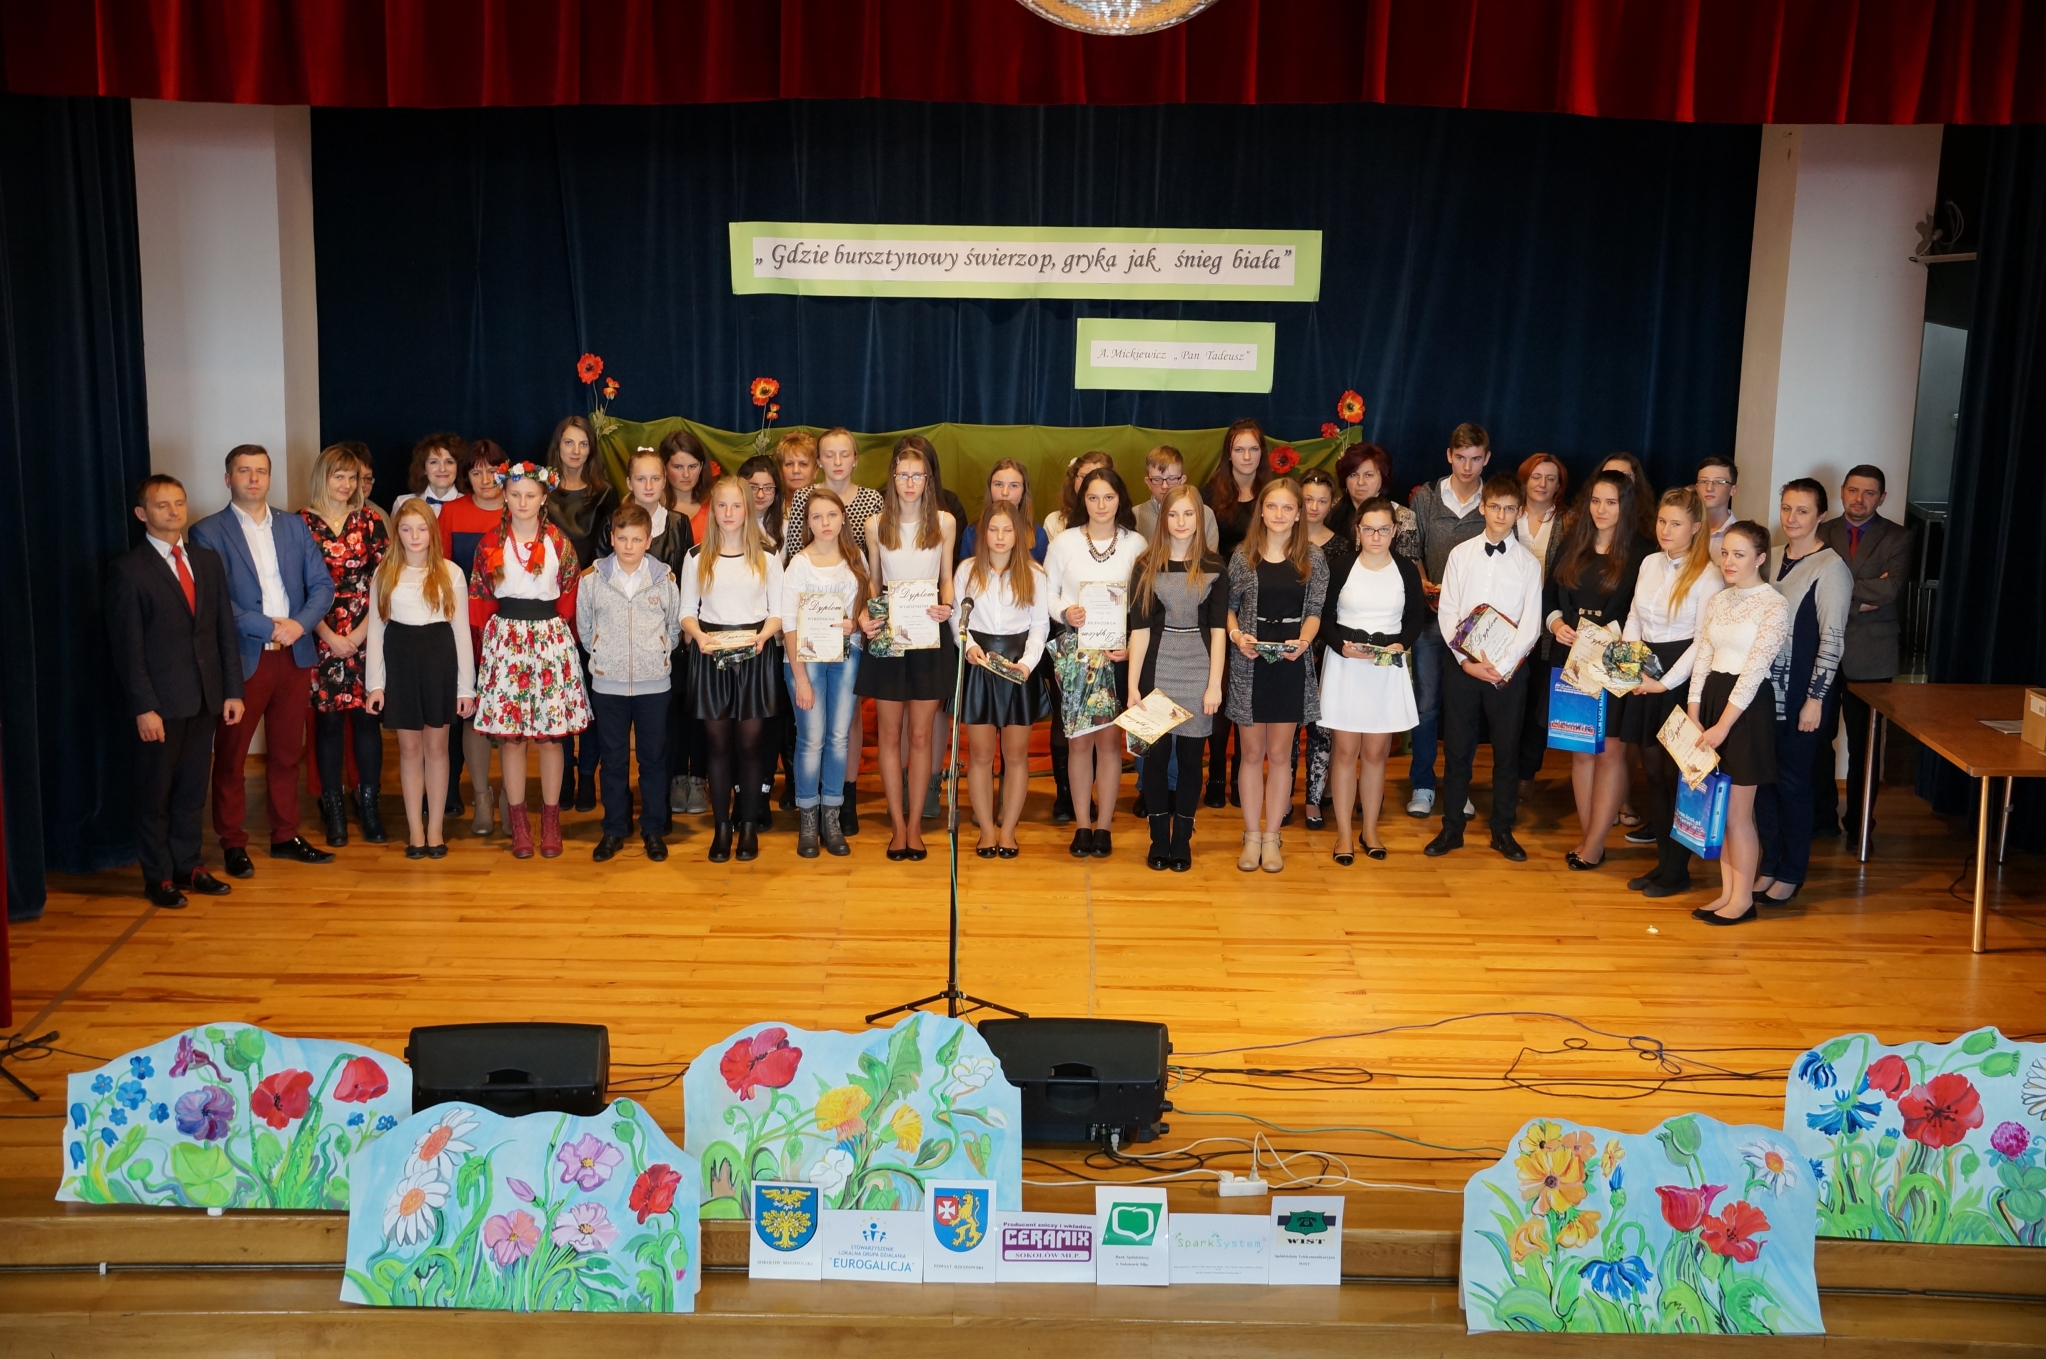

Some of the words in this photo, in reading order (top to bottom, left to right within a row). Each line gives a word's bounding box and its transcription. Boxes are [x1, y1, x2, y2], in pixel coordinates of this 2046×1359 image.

[834, 244, 959, 272] bursztynowy
[964, 247, 1056, 273] świerzop,
[1061, 247, 1117, 274] gryka
[1123, 247, 1161, 274] jak
[1174, 249, 1223, 275] śnieg
[1097, 349, 1109, 359] A.
[1111, 348, 1167, 361] Mickiewicz
[899, 587, 935, 602] Dyplom
[808, 599, 842, 614] Dyplom
[1474, 616, 1498, 646] Dyplom
[1585, 630, 1607, 648] Dyplo
[1063, 1222, 1093, 1230] wkładów
[1005, 1230, 1090, 1249] CERAMIX
[1177, 1238, 1261, 1249] SparkSystem
[850, 1244, 894, 1252] STOWARZYSZENIE
